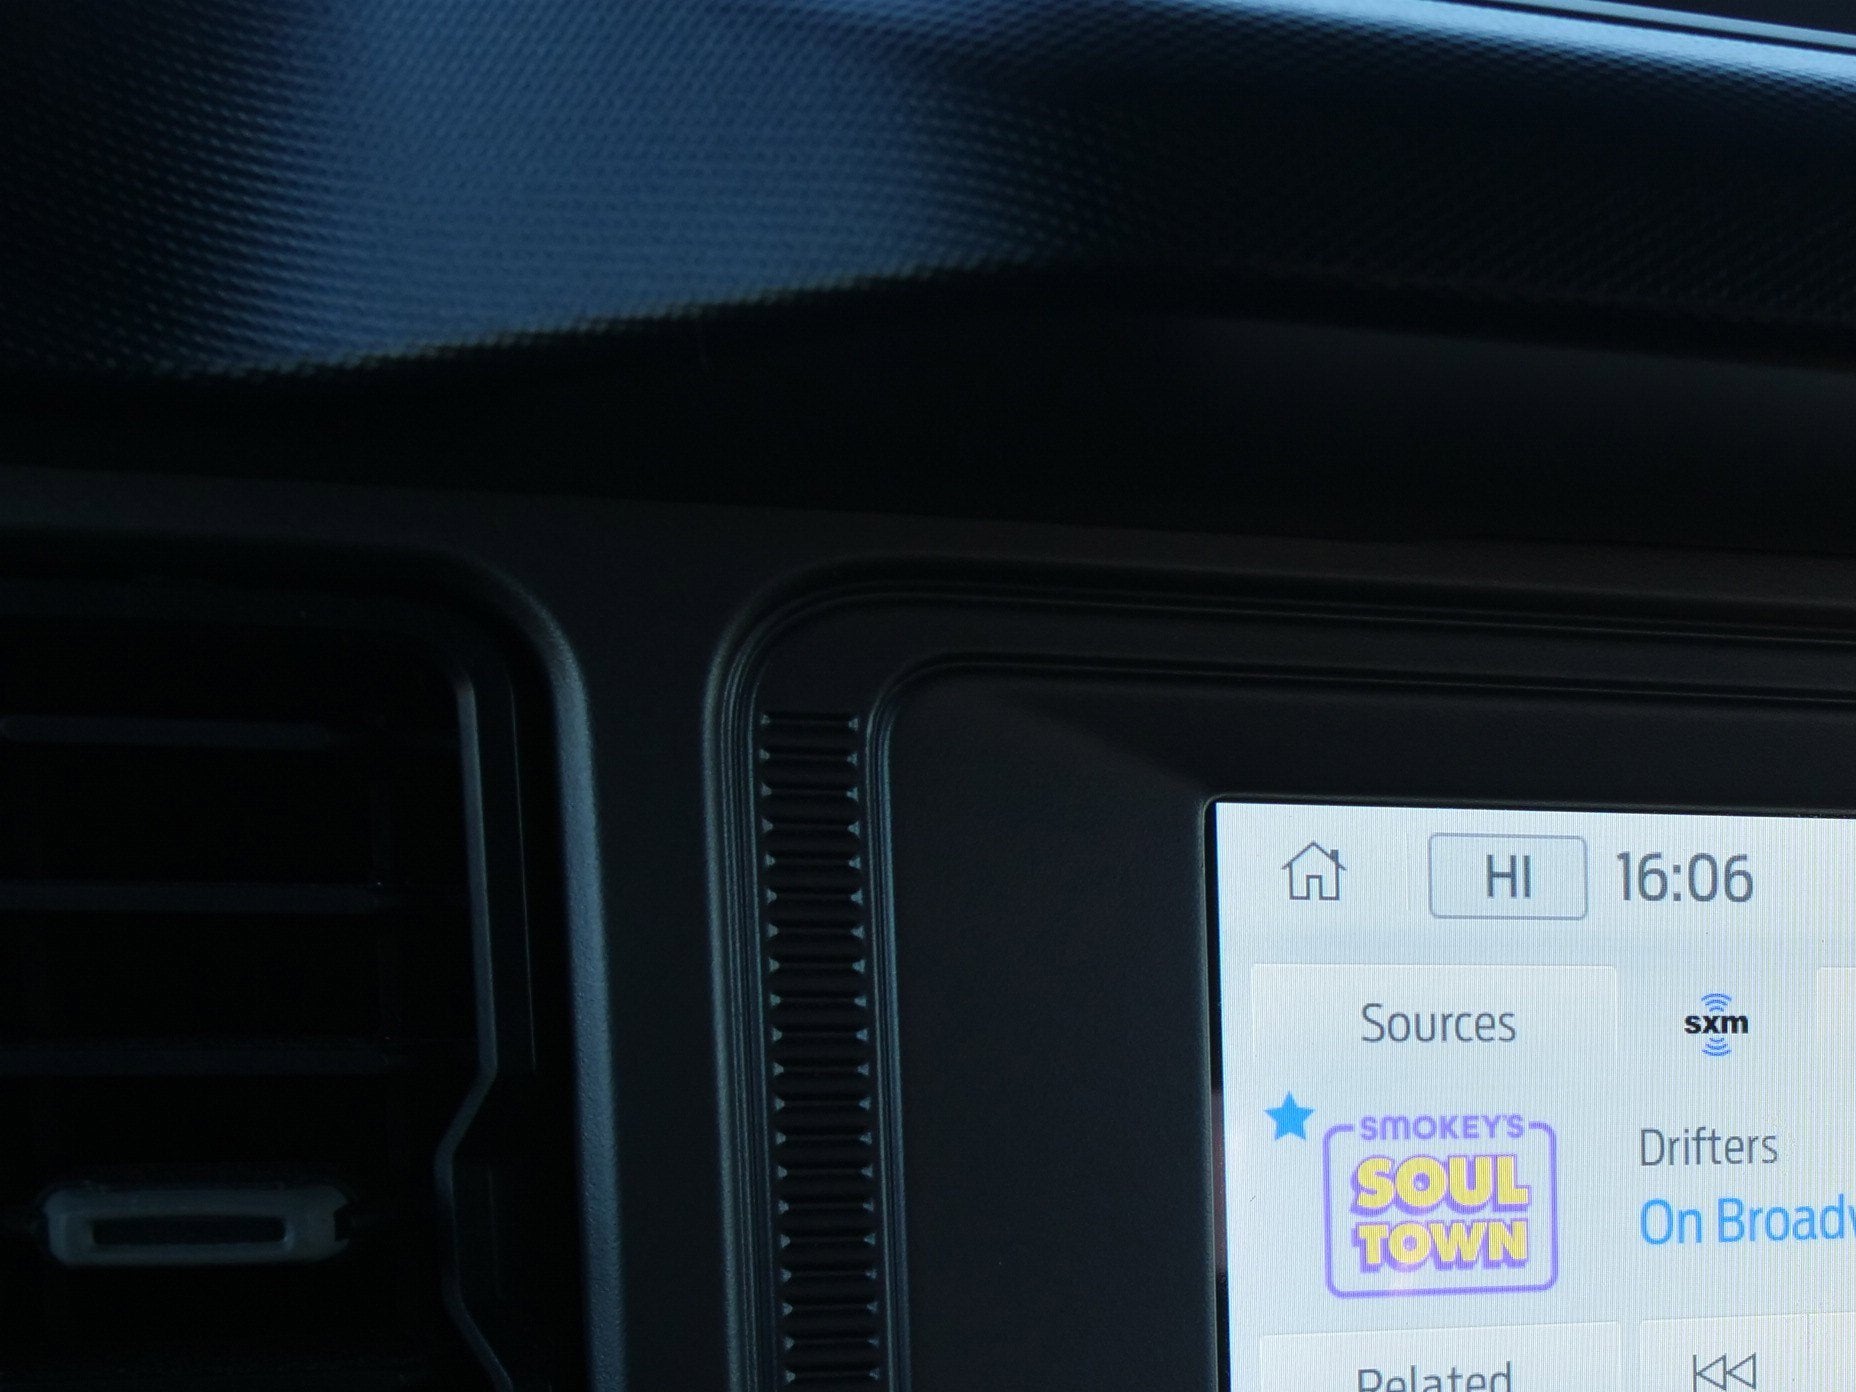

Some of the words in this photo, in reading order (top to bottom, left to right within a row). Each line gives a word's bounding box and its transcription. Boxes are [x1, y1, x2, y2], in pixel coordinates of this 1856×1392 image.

[1486, 854, 1532, 899] HI
[1616, 851, 1755, 904] 16:06
[1360, 1002, 1518, 1044] Sources
[1684, 1011, 1750, 1036] sxm
[1639, 1126, 1779, 1167] Drifters
[1350, 1154, 1532, 1215] SOUL
[1639, 1198, 1704, 1246] On
[1352, 1218, 1530, 1274] TOWN
